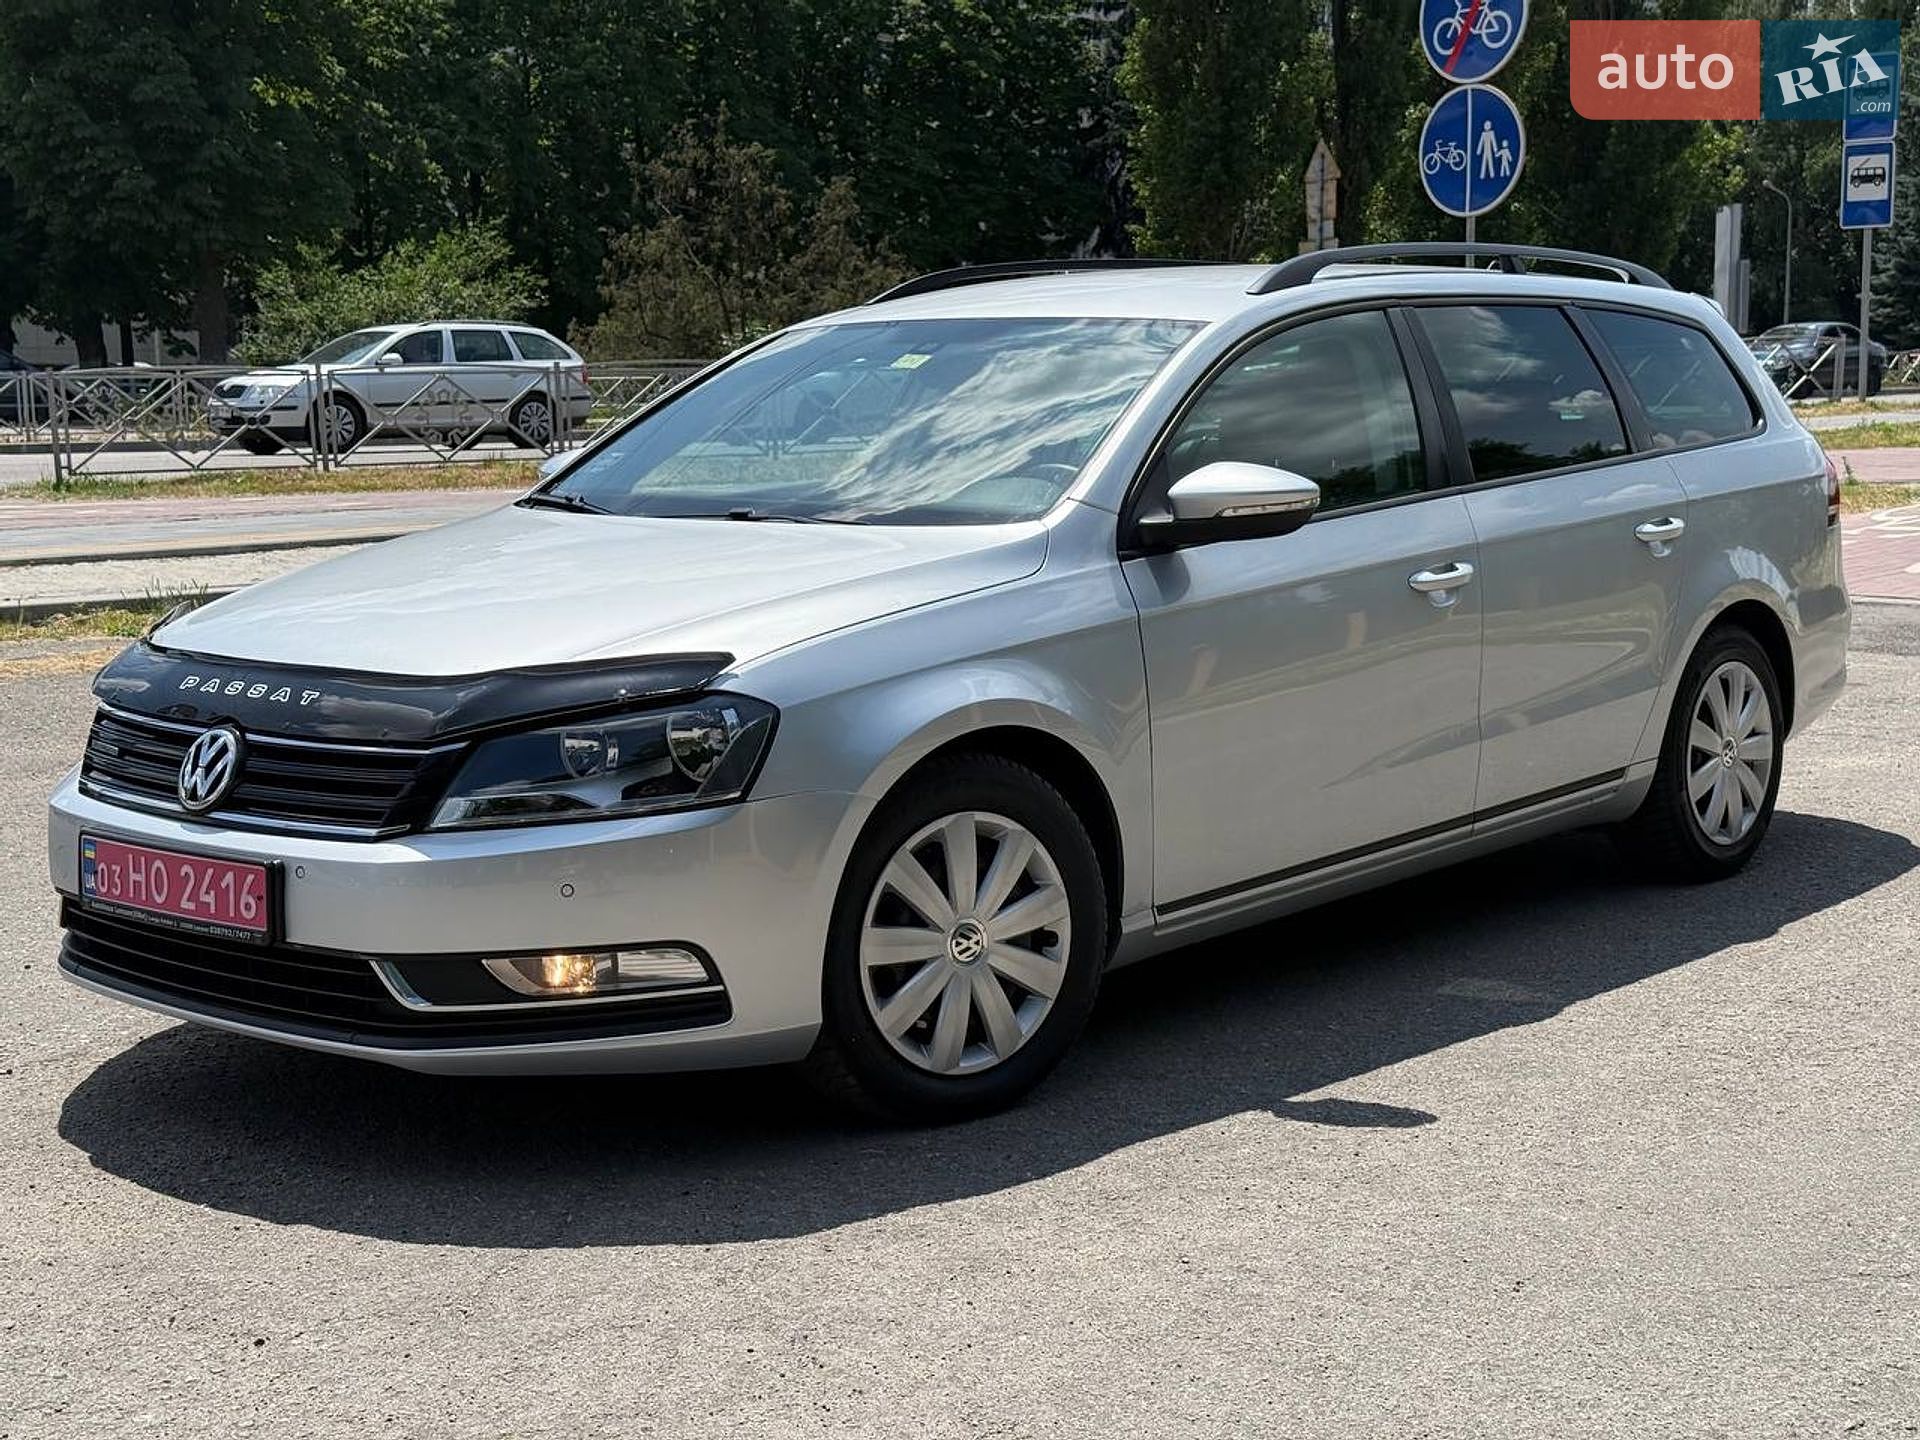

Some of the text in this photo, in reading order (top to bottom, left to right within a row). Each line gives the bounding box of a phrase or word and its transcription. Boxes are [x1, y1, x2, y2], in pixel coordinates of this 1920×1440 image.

[178, 676, 320, 705] PASSAT
[97, 862, 122, 896] 03
[179, 864, 257, 919] 2416
